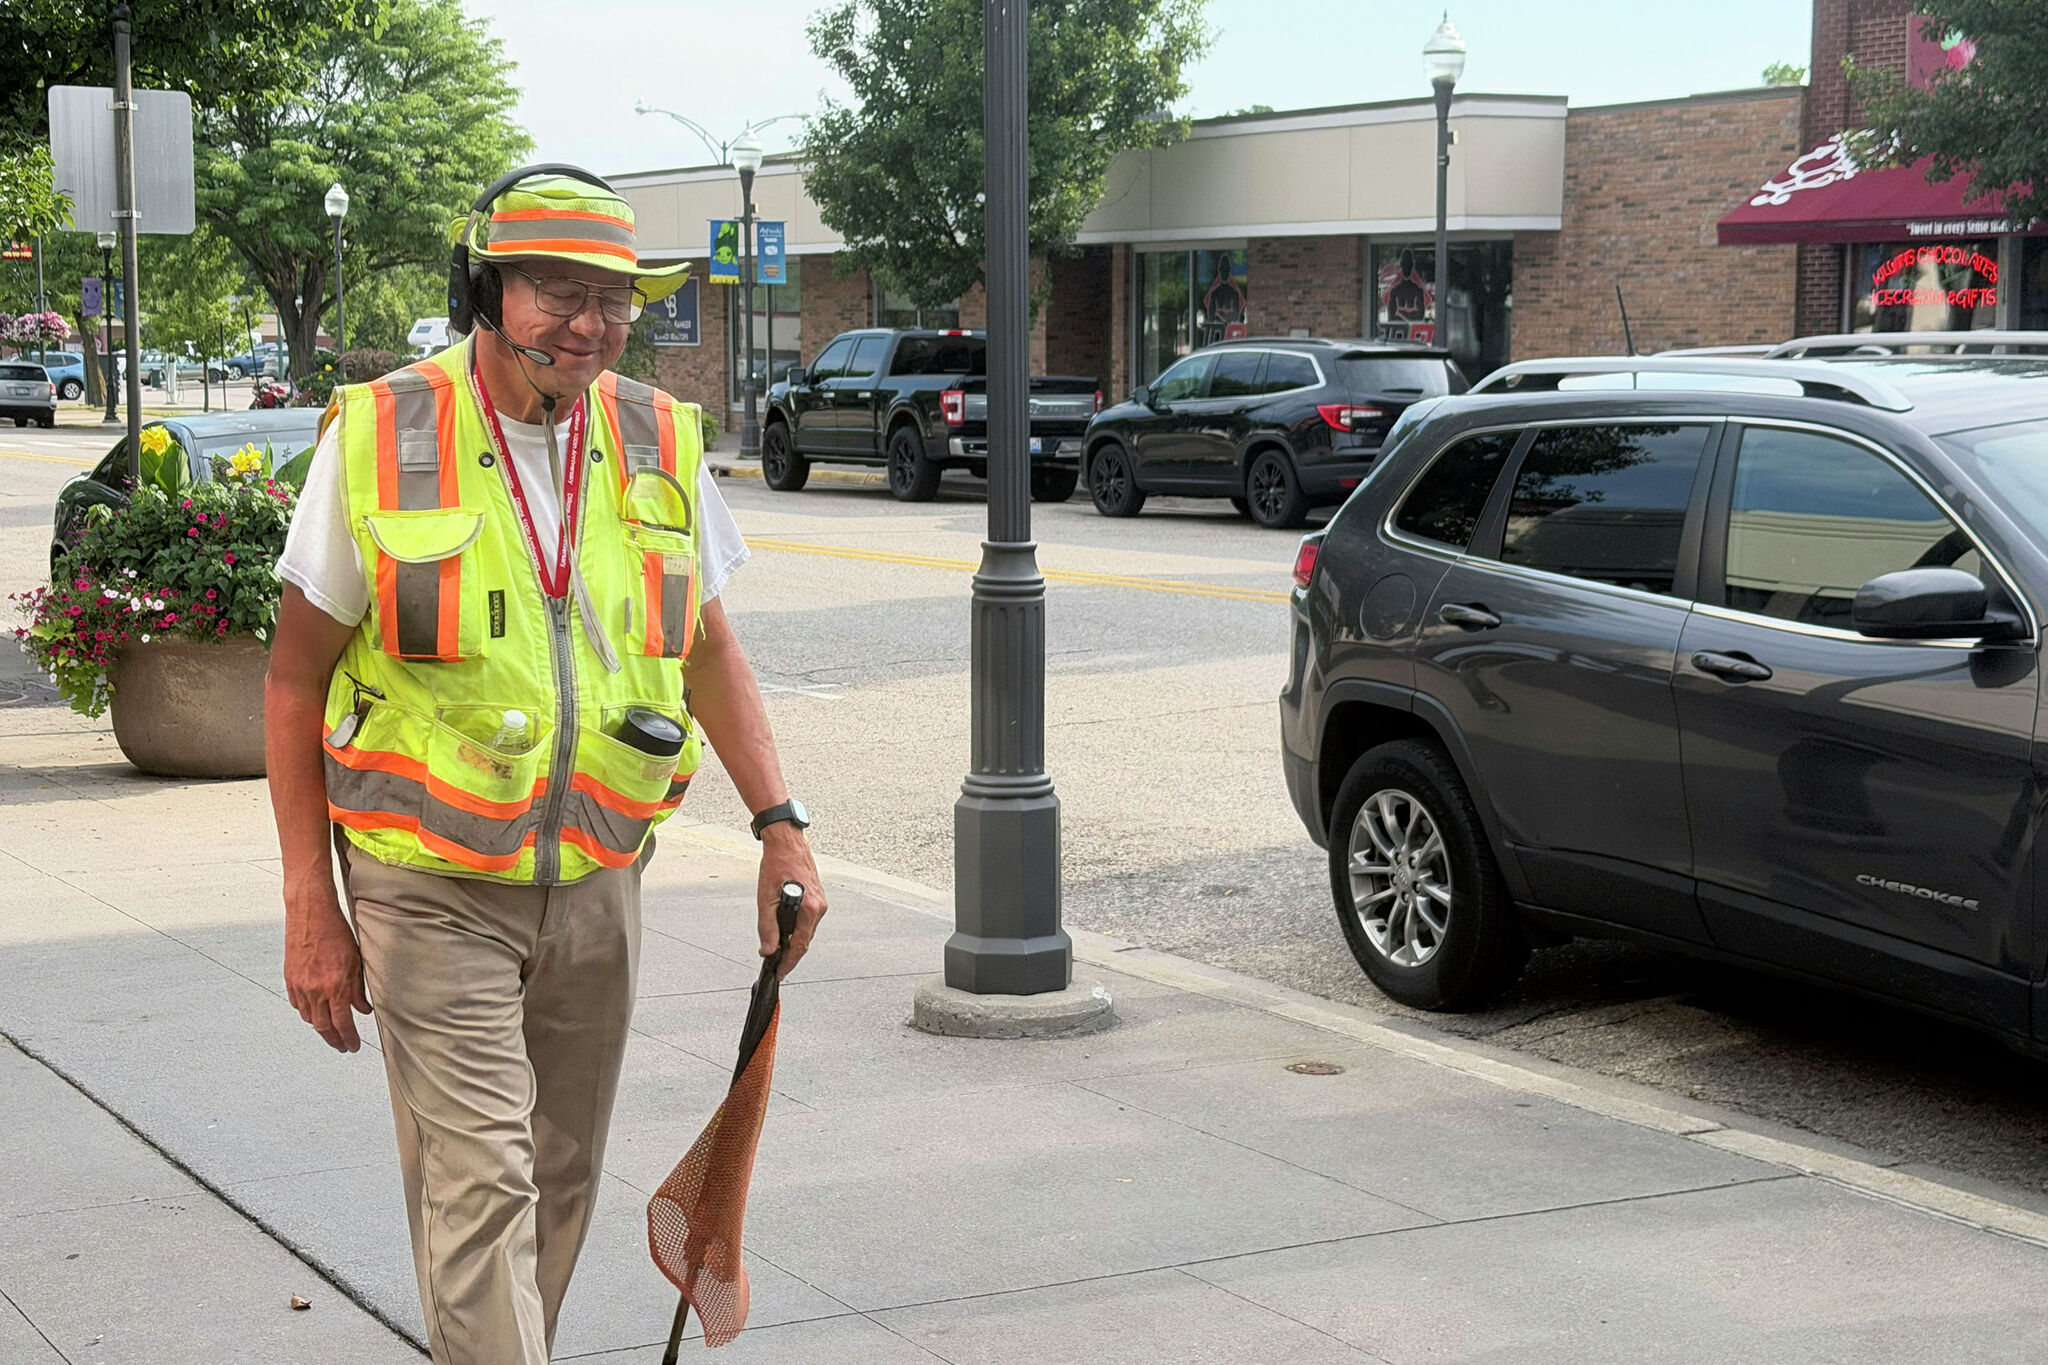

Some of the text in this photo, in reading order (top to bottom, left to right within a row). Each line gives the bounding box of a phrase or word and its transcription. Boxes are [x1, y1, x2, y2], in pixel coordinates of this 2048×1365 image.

[1917, 245, 1999, 283] CHOCOLATES
[567, 449, 577, 485] Anniversary
[526, 535, 542, 571] Anniversary
[1856, 874, 1979, 911] CHEROKEE
